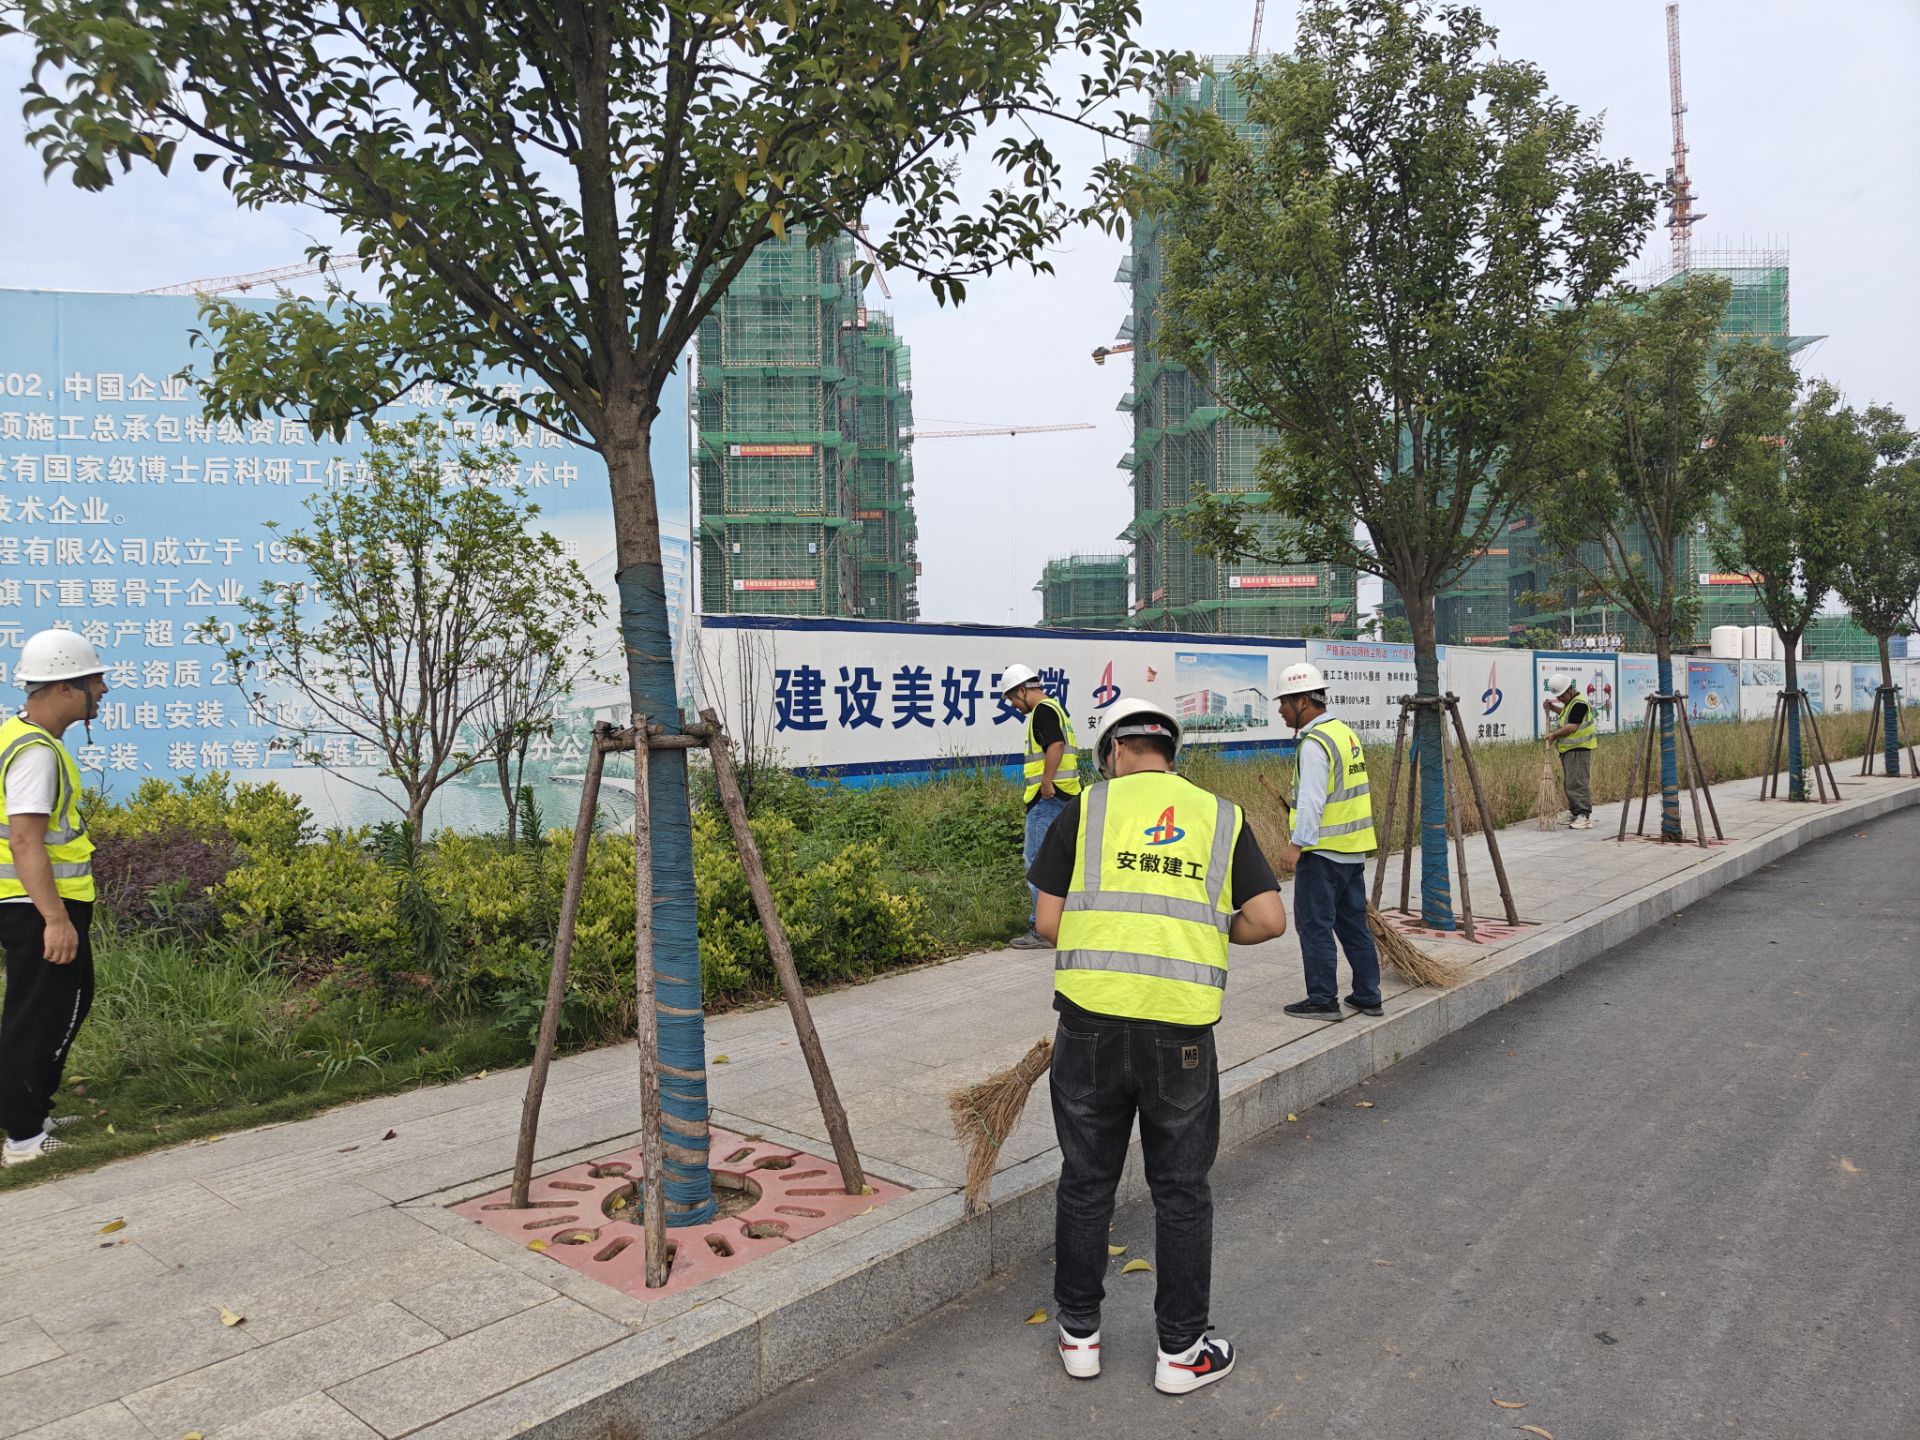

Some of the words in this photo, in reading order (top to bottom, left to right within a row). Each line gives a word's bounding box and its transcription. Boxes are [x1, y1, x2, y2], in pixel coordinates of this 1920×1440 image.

[253, 540, 322, 564] 195
[1478, 722, 1507, 738] 安徽建工
[1116, 850, 1205, 882] 安徽建工
